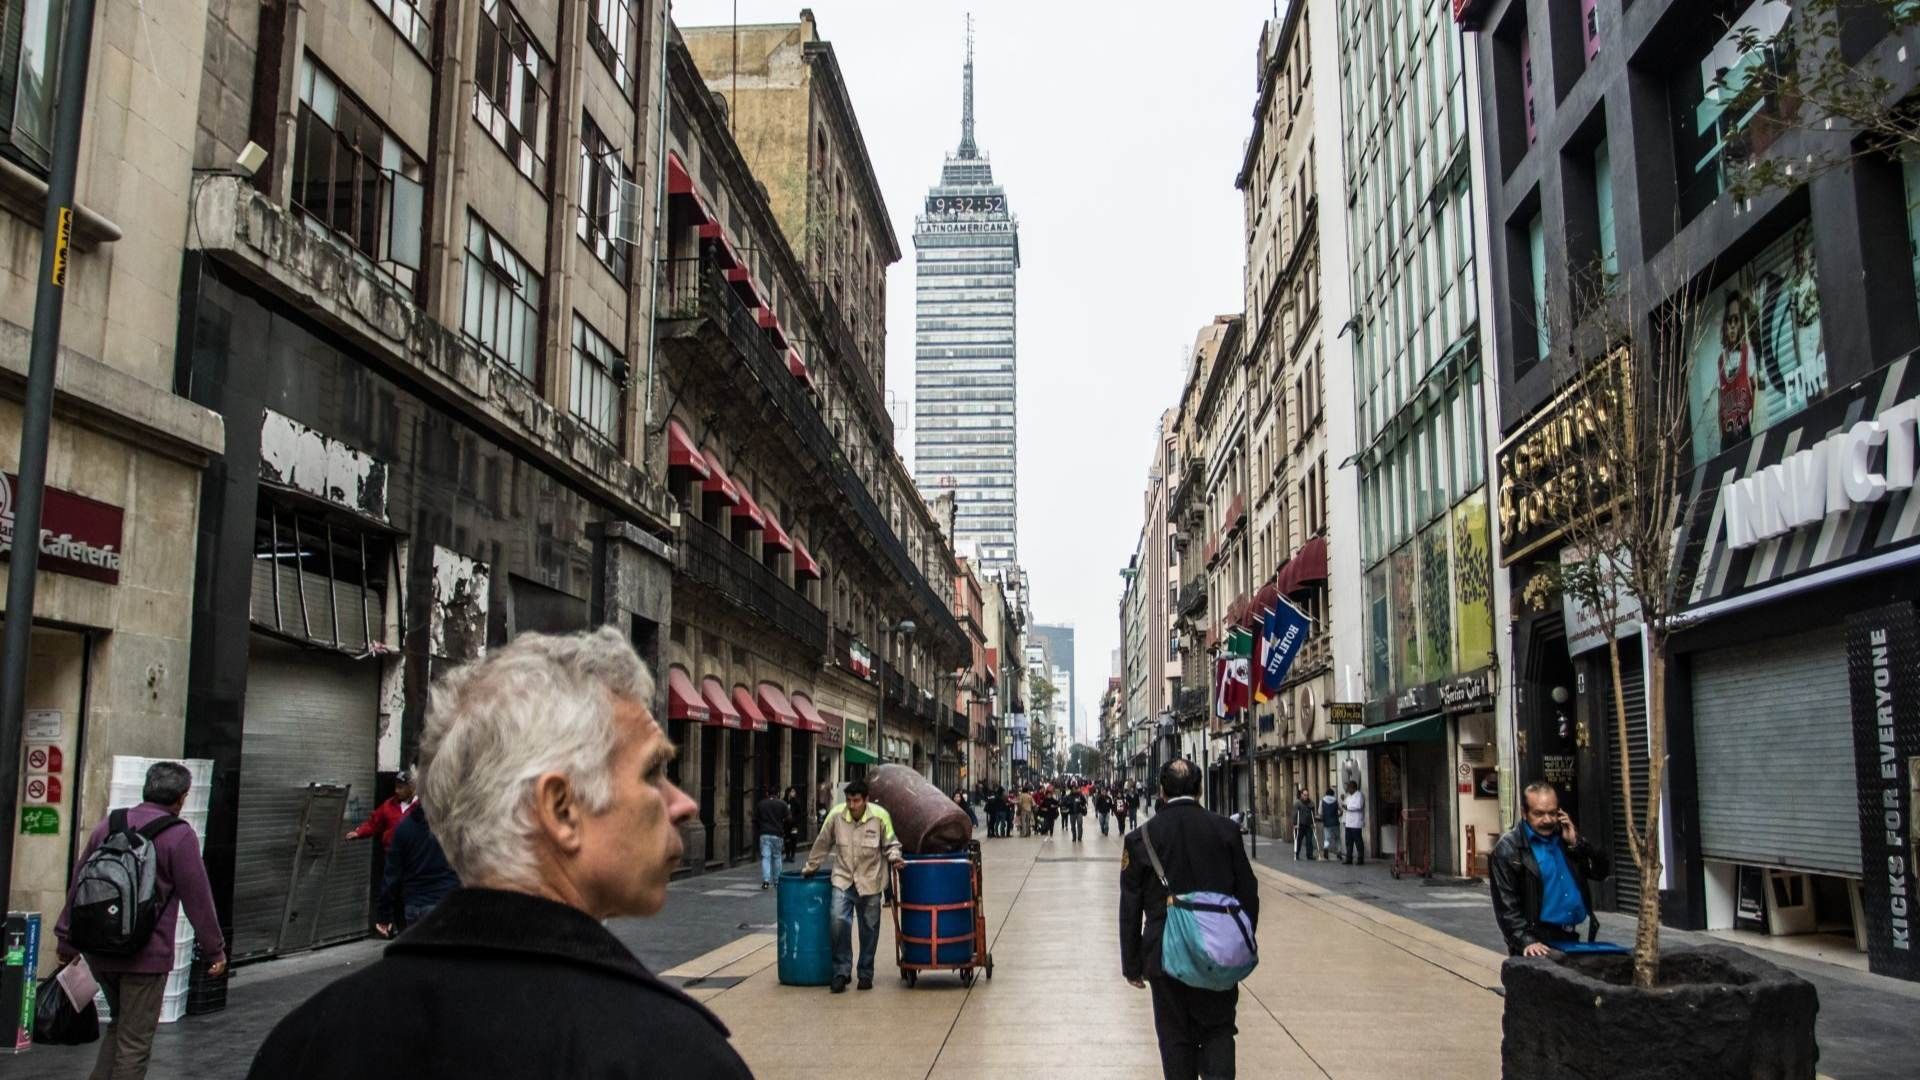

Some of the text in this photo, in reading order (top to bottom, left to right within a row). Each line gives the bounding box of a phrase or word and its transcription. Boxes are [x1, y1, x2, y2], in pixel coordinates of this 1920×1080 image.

[936, 197, 1003, 213] 9:32:52
[920, 223, 1009, 233] LATINOAMERICANA
[1723, 395, 1920, 549] INNVICT
[39, 529, 121, 570] Cafetería
[1870, 628, 1909, 951] KICKS FOR EVERYONE
